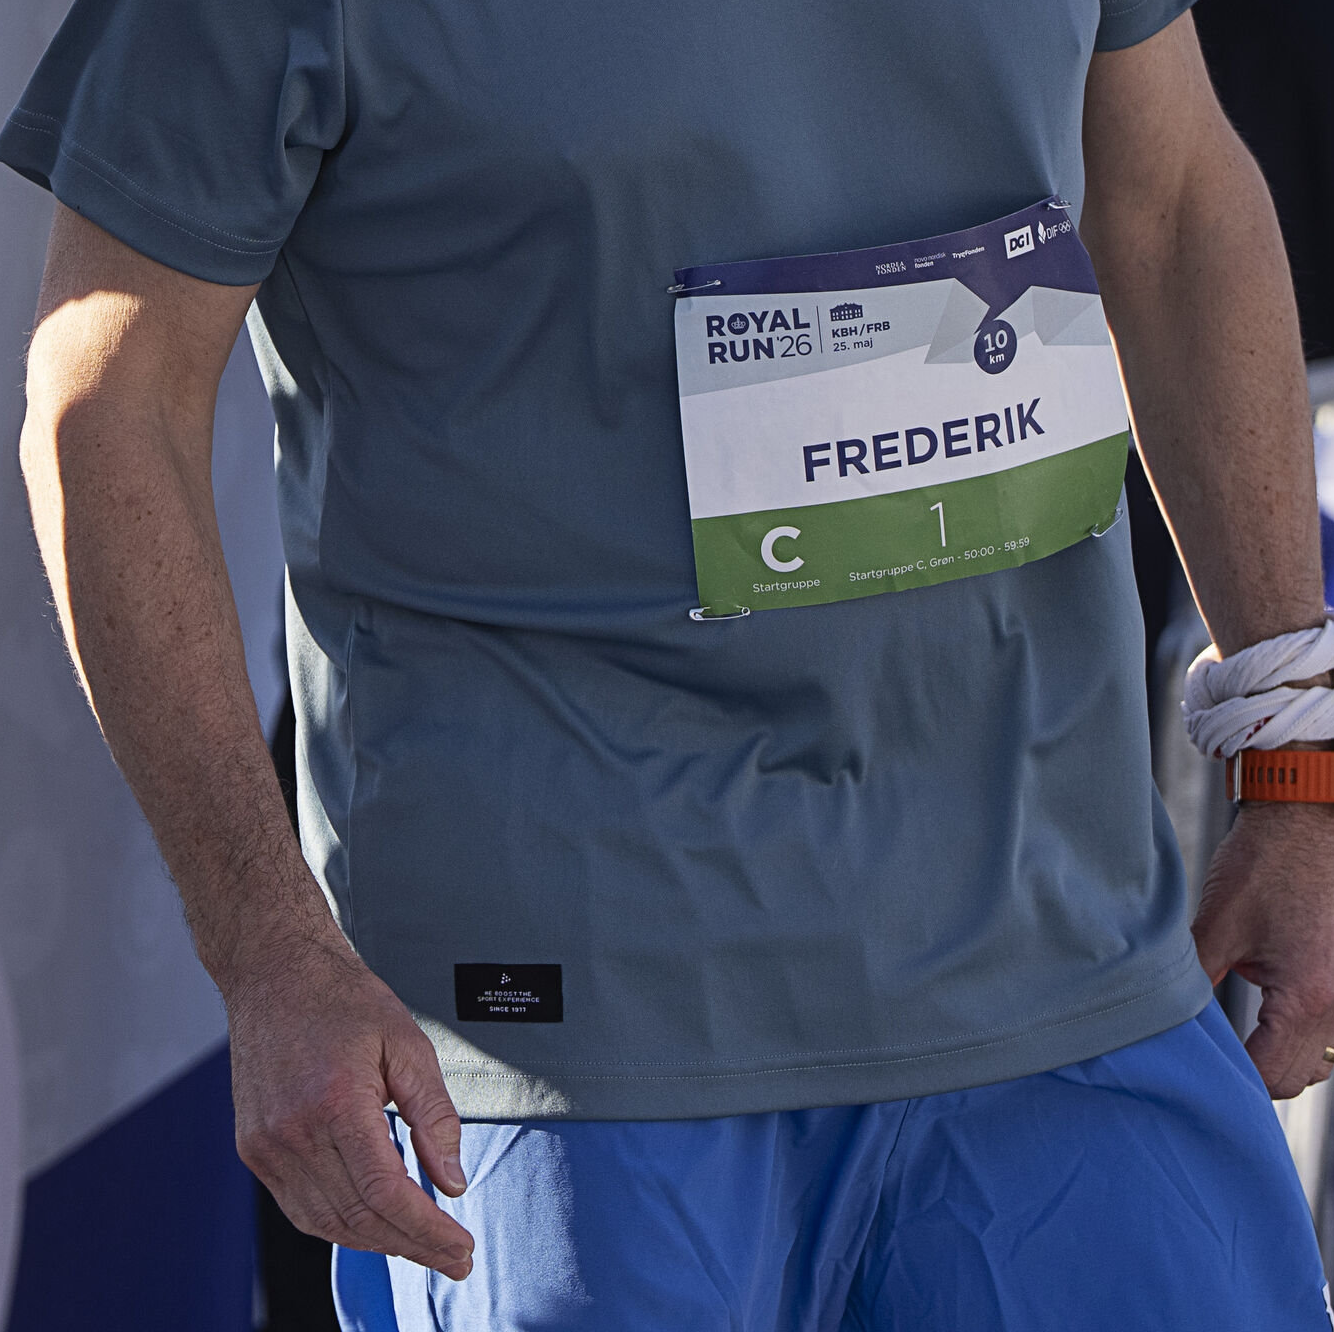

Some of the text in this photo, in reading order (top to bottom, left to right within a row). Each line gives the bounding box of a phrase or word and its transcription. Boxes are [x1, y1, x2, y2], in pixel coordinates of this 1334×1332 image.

[1009, 224, 1059, 253] DGI DIF
[705, 307, 811, 338] ROYAL
[831, 320, 892, 339] KBH/FRB
[833, 338, 874, 352] 25. maj
[983, 329, 1008, 353] 10
[989, 353, 1005, 365] km
[802, 397, 1046, 483] FREDERIK
[929, 501, 947, 548] 1
[760, 525, 805, 573] C
[849, 562, 915, 583] Startgruppe
[916, 559, 928, 571] C,
[929, 554, 956, 568] Grøn
[964, 545, 996, 561] 50:00
[1004, 535, 1031, 552] 59:59
[752, 577, 822, 594] Startgruppe
